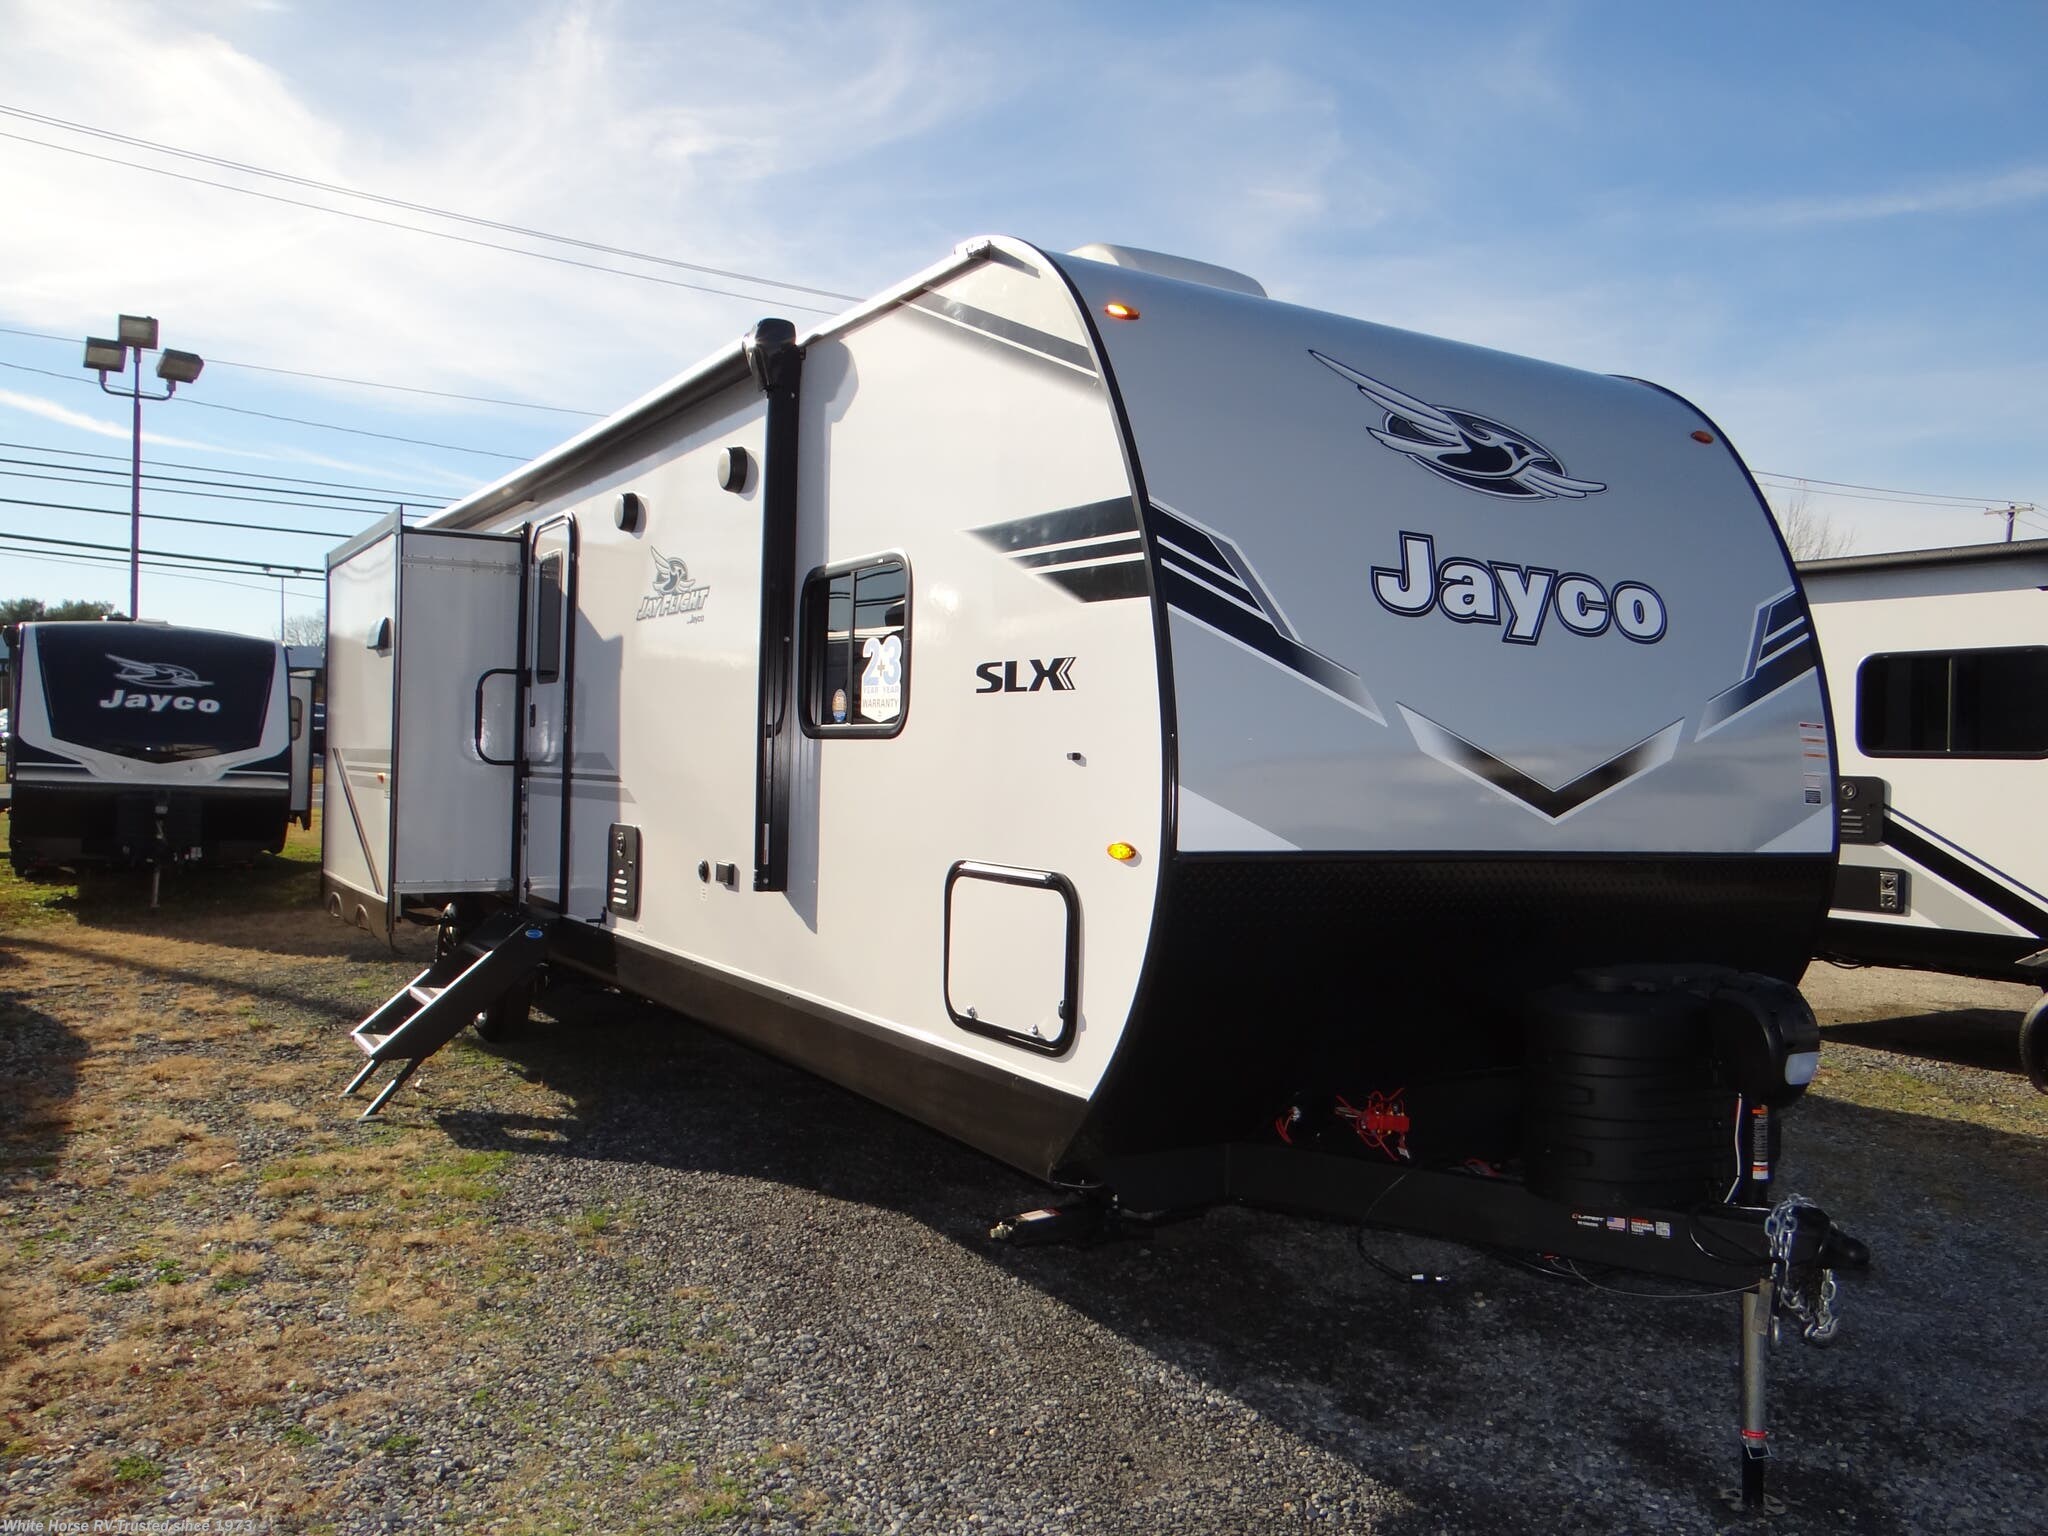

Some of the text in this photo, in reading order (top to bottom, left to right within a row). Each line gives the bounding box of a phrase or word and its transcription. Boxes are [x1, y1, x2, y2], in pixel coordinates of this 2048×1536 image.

[636, 586, 710, 621] JAY FLIGHT
[1370, 530, 1668, 646] Jayco
[975, 657, 1077, 694] SLX
[99, 689, 220, 713] Jayco
[862, 698, 899, 708] WARRANTY
